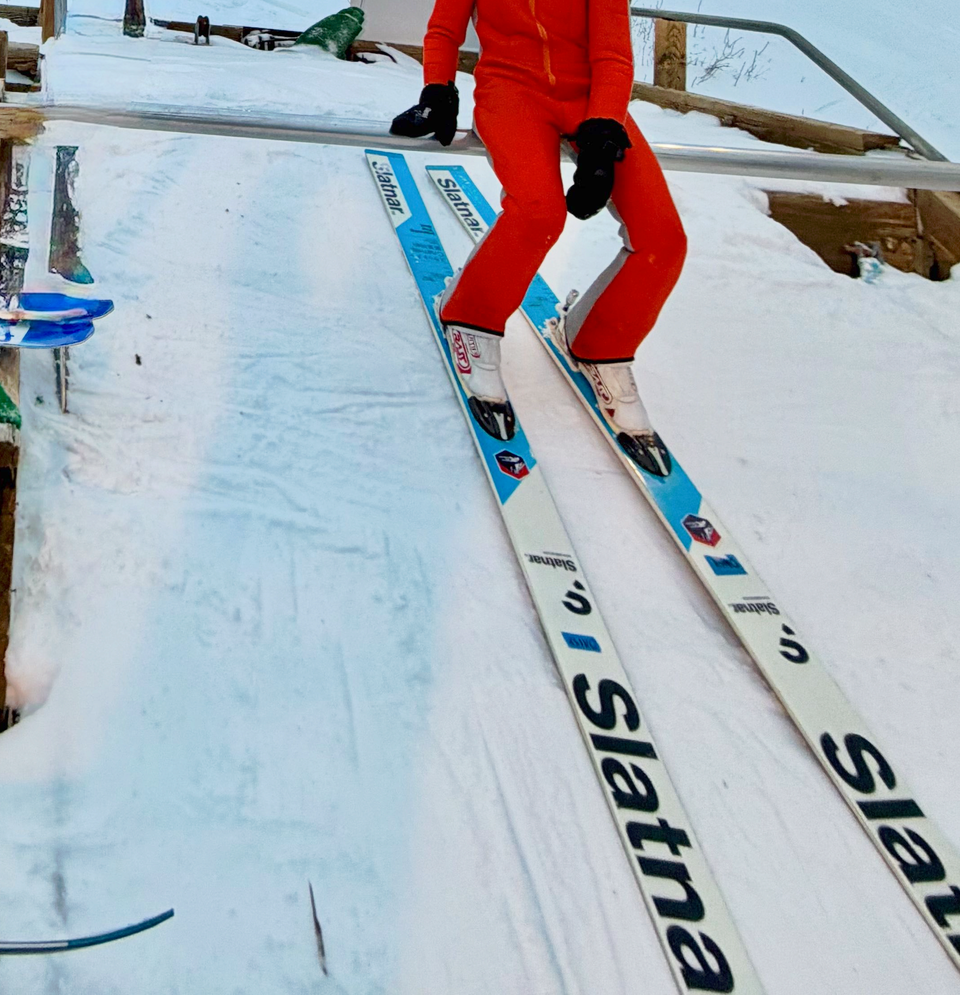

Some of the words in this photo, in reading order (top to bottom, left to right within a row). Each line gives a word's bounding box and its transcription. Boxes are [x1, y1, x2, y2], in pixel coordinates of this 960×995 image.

[437, 178, 484, 234] Slatnar
[526, 553, 577, 573] Slatnar
[733, 601, 781, 616] Slatnar
[572, 673, 735, 995] Slatna
[819, 731, 960, 956] Slat
